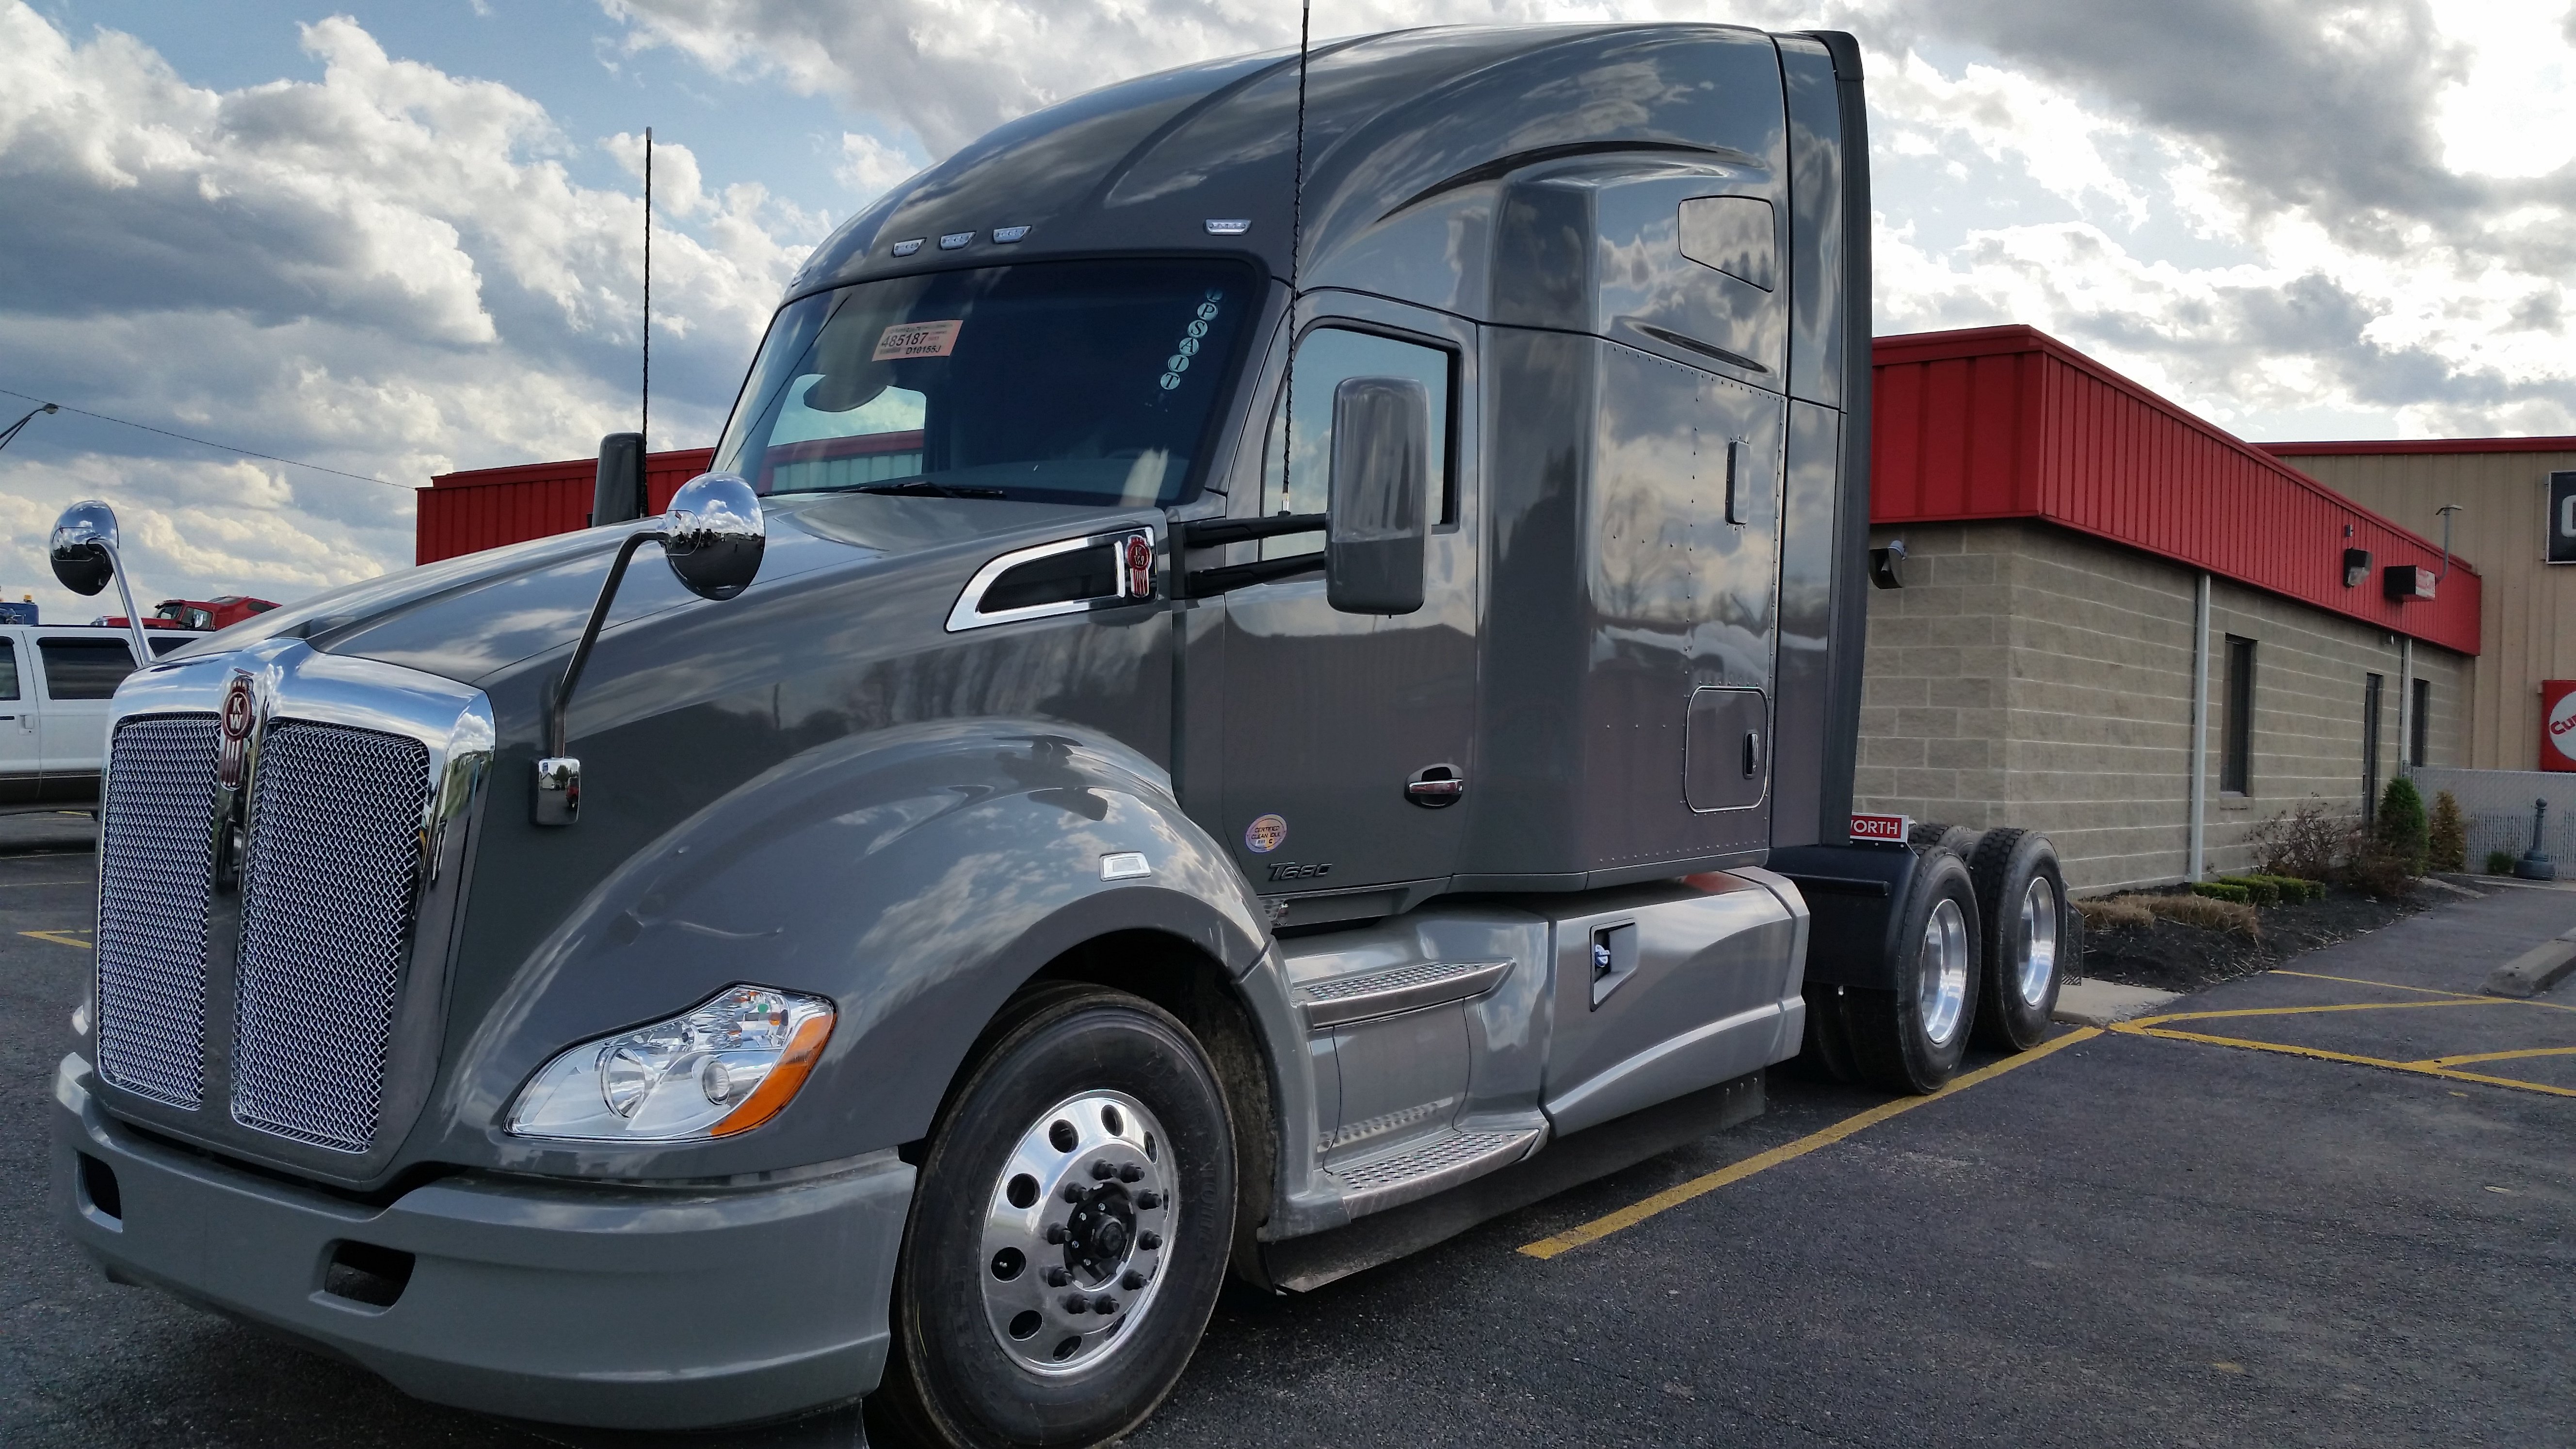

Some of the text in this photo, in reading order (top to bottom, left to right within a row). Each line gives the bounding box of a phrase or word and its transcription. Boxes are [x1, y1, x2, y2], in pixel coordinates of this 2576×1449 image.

[882, 332, 929, 348] 485187
[906, 345, 941, 354] D10155J
[1851, 820, 1898, 835] ORTH
[1269, 862, 1332, 881] T680
